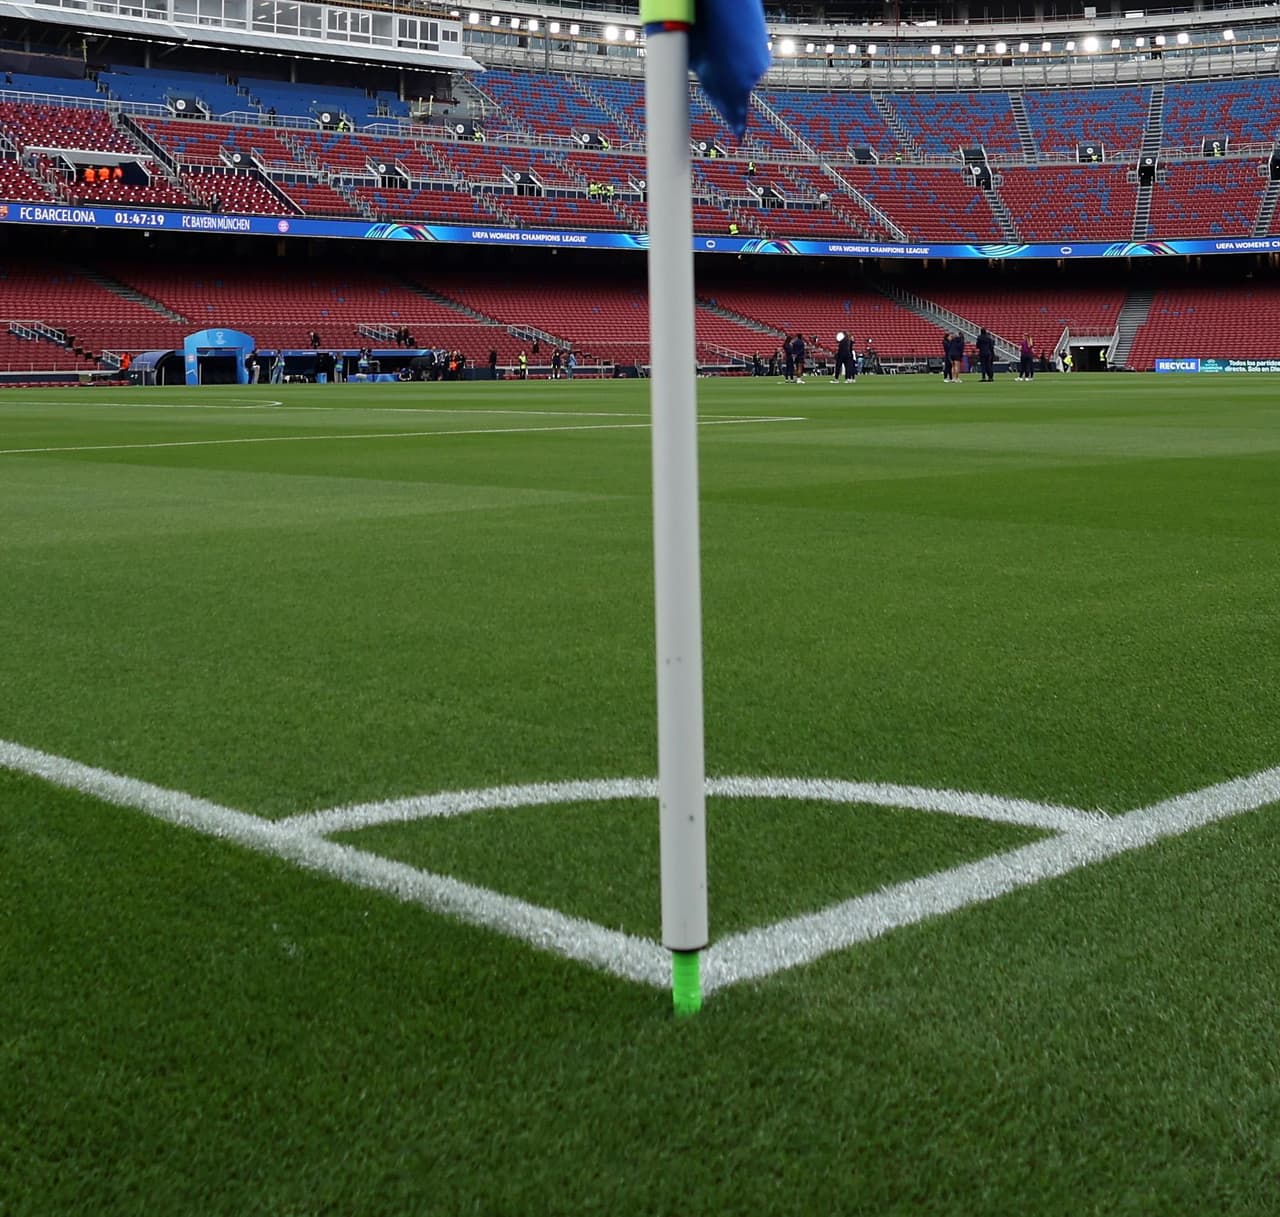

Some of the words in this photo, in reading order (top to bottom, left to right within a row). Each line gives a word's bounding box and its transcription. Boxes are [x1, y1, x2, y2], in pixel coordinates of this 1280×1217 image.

[20, 207, 33, 220] FC
[34, 207, 95, 223] BARCELONA
[115, 212, 165, 226] 01:47:19
[182, 215, 190, 228] FC
[191, 216, 217, 230] BAYERN
[217, 215, 251, 231] MÜNCHEN
[472, 231, 489, 239] UEFA
[521, 233, 561, 242] CHAMPIONS
[1215, 242, 1234, 250] UEFA
[1159, 361, 1196, 370] RECYCLE
